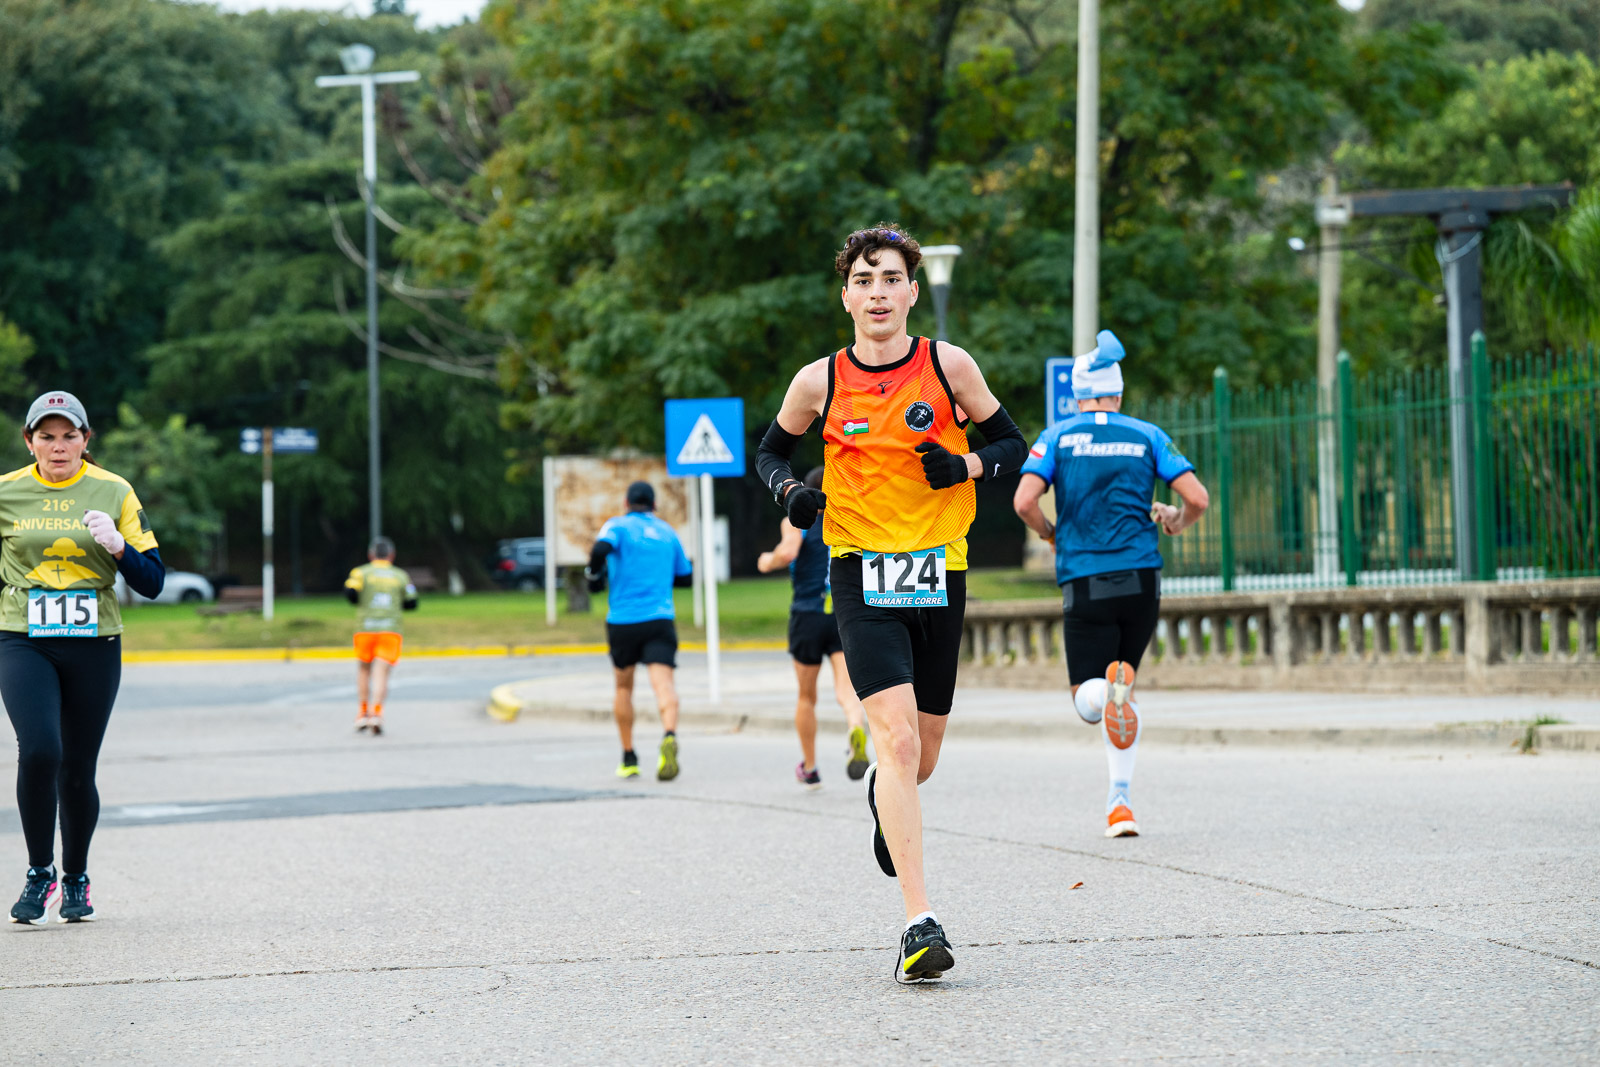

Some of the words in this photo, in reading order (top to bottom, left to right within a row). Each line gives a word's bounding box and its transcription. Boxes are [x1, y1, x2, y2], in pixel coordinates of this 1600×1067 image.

[1057, 396, 1079, 415] CA
[1058, 432, 1094, 449] SIN
[1072, 442, 1146, 457] LIMITES
[42, 498, 76, 512] 216°
[869, 551, 940, 594] 124
[868, 597, 913, 605] DIAMANTE
[914, 597, 943, 605] CORRE
[34, 594, 91, 626] 115
[32, 628, 69, 636] DIAMANTE
